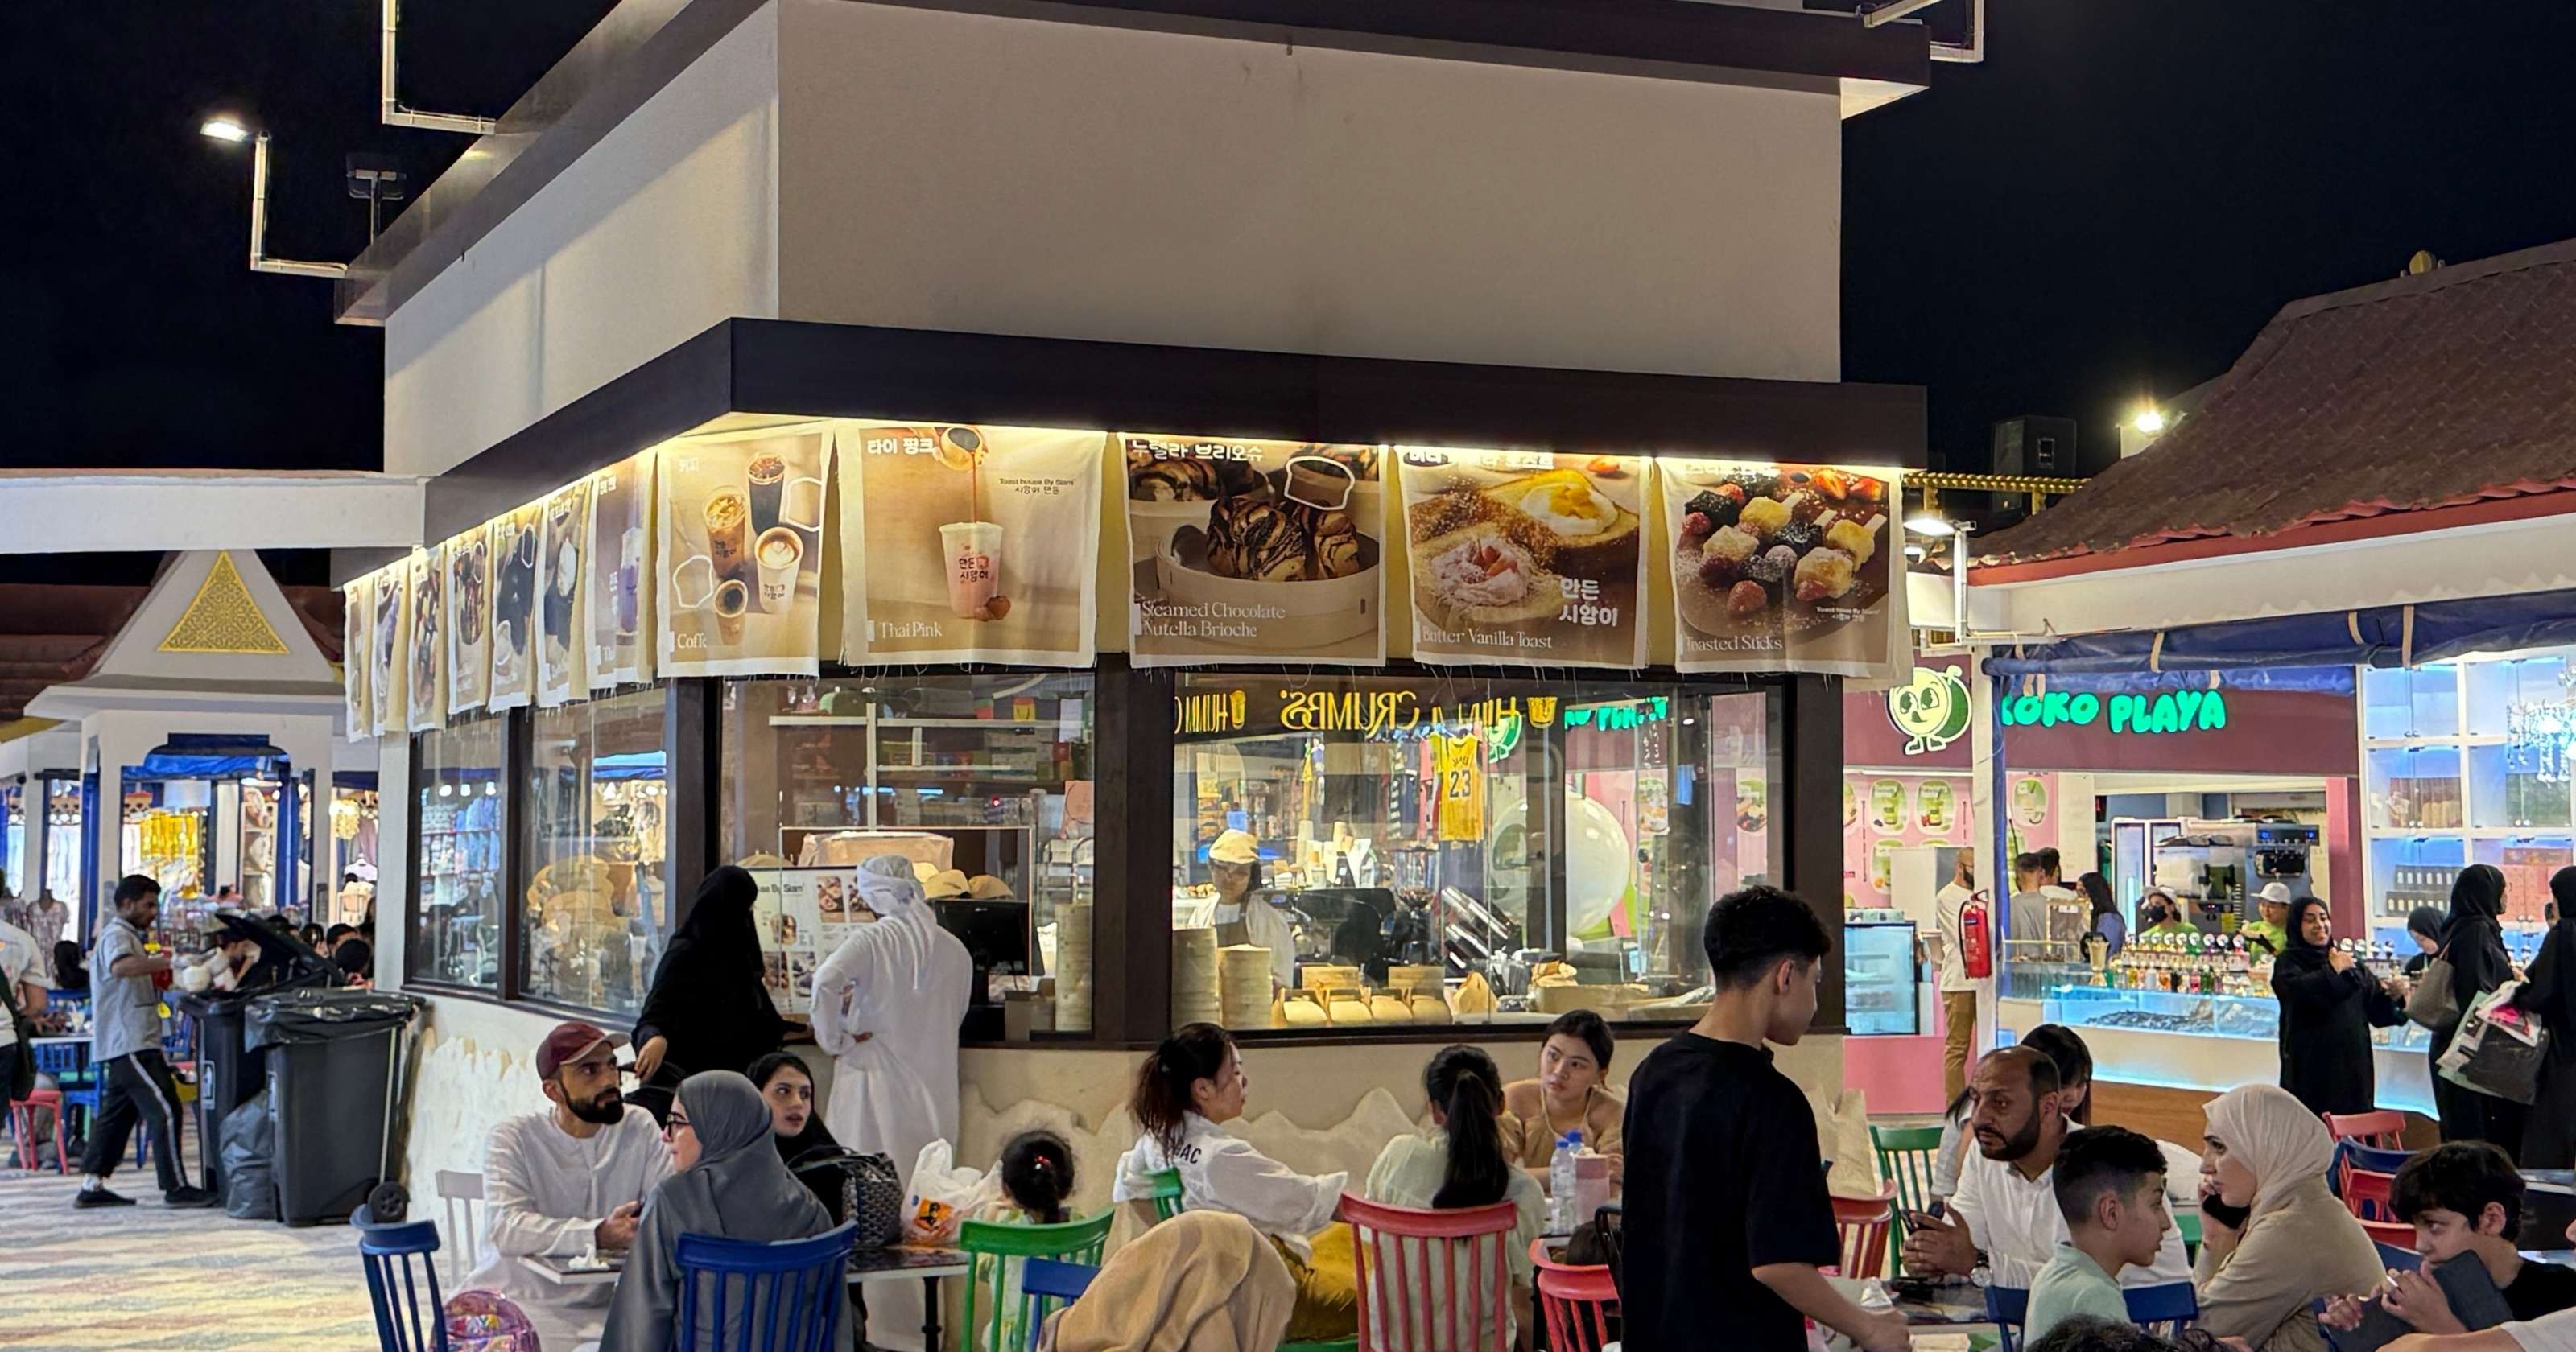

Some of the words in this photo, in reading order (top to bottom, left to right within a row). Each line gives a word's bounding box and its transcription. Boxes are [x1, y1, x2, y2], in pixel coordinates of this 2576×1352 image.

[867, 439, 898, 455] 타이
[902, 437, 935, 455] 핑크
[1195, 443, 1263, 462] 브리오슈
[1560, 578, 1600, 600] 만든
[1141, 600, 1208, 617] Steamed
[1212, 601, 1286, 619] Chocolate
[881, 621, 910, 638] Thai
[912, 620, 943, 637] Pink
[1144, 620, 1197, 637] Nutella
[1200, 620, 1257, 637] Brioche
[1422, 625, 1465, 643] Butter
[1468, 628, 1514, 646] Vanilla
[1516, 630, 1552, 649] Toast
[1686, 634, 1739, 651] Toasted
[1740, 634, 1783, 650] Sticks
[2108, 689, 2226, 733] PLAYA
[1449, 769, 1472, 798] 23
